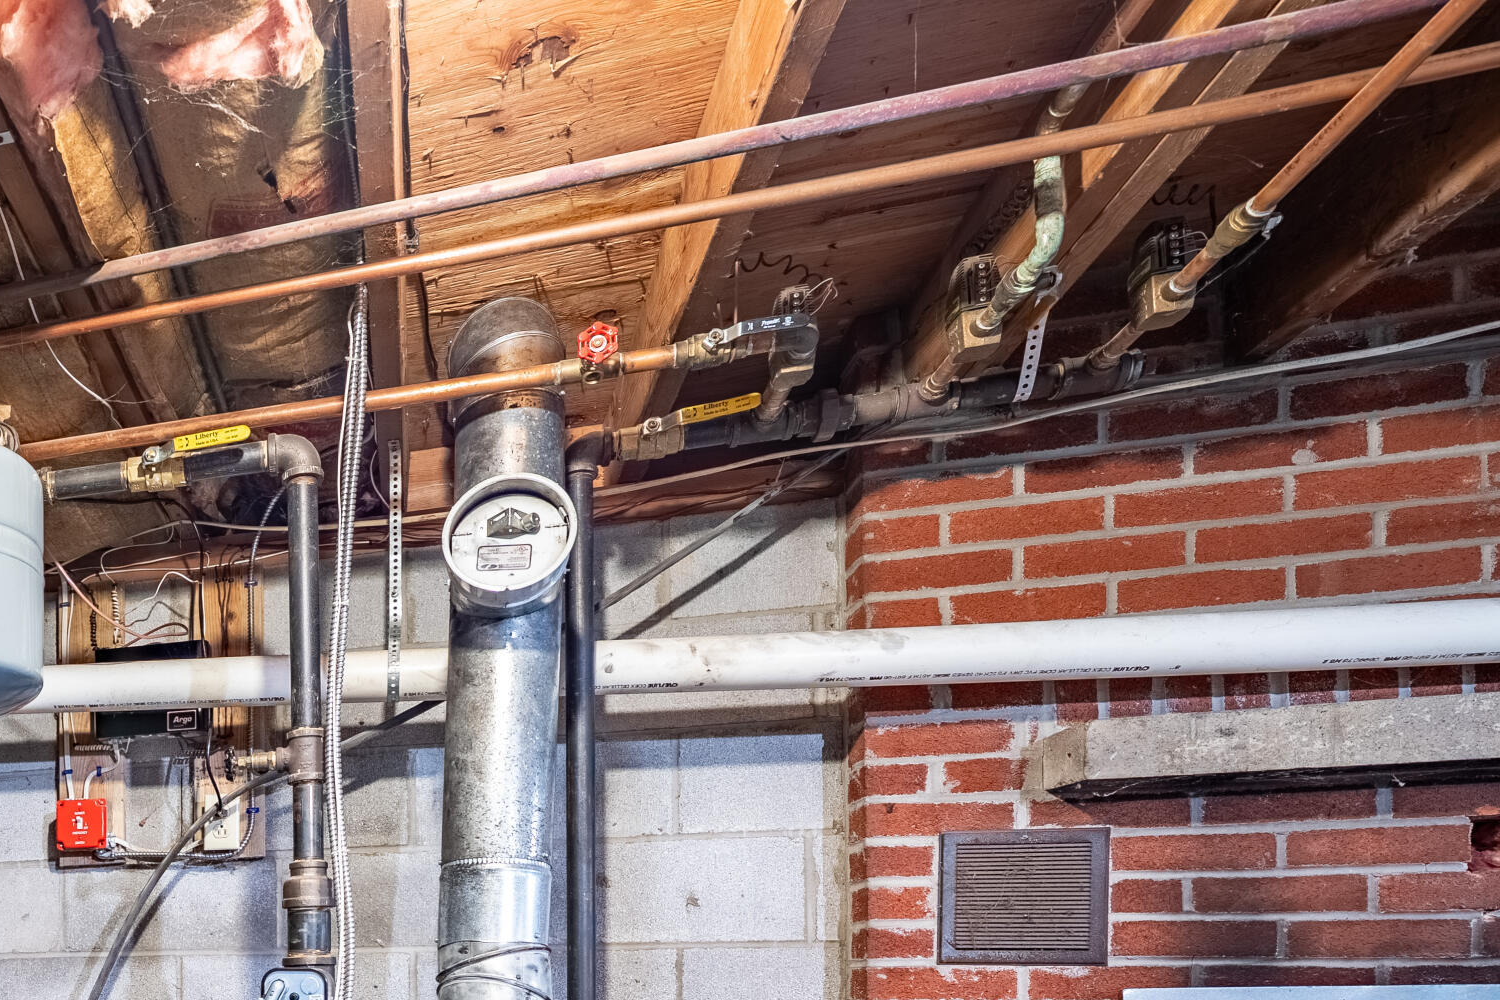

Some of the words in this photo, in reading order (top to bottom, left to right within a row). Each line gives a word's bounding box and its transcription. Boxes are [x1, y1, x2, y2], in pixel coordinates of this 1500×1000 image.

[703, 401, 729, 410] Liberty
[195, 431, 219, 440] Liberty
[173, 716, 193, 725] Argo
